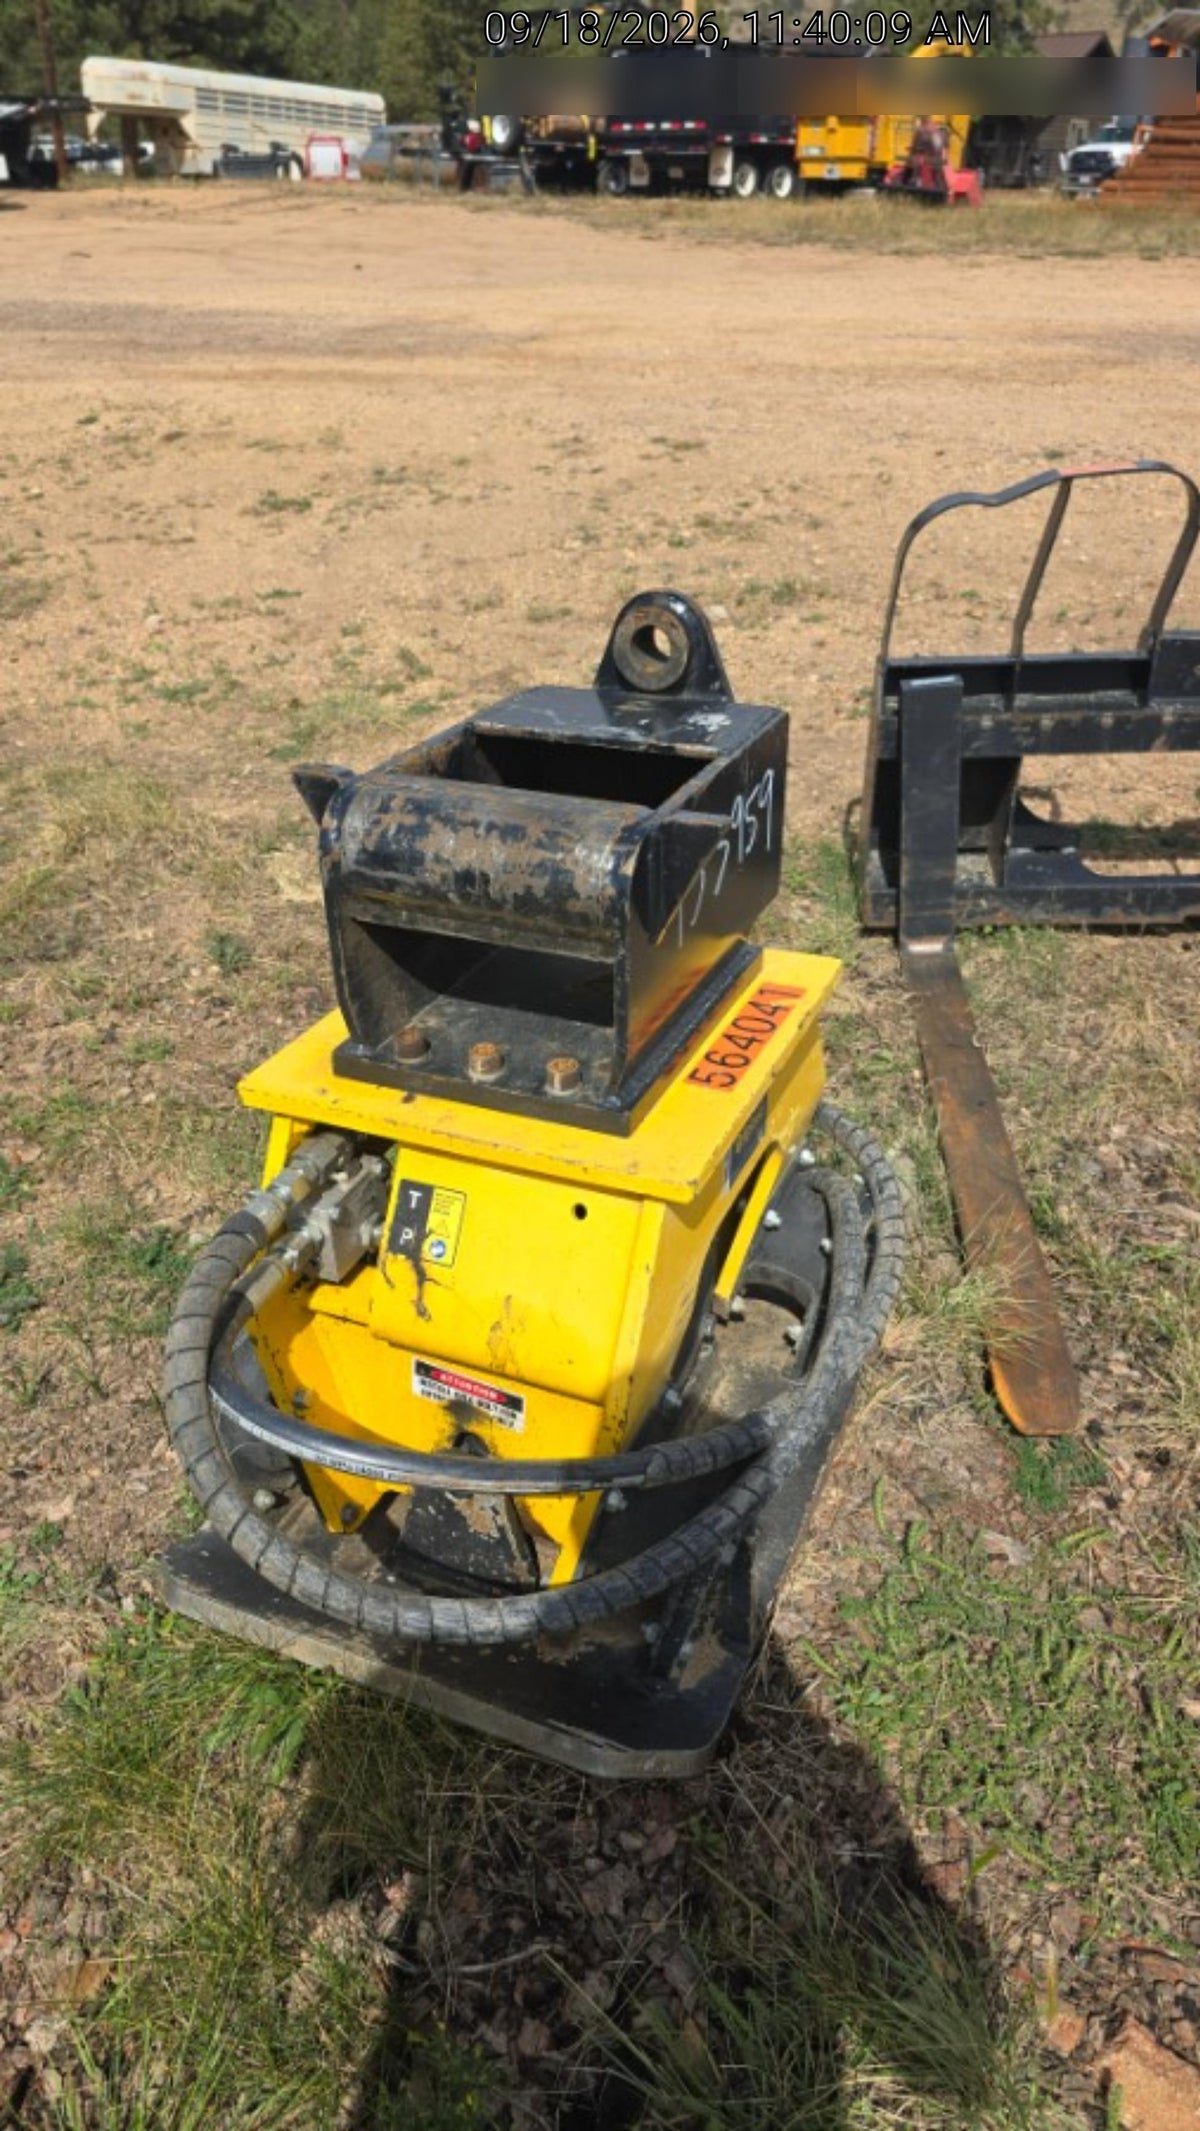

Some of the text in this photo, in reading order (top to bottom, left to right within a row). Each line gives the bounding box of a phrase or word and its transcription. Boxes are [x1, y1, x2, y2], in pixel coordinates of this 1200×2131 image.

[687, 988, 802, 1088] 564041
[408, 1190, 423, 1209] T
[399, 1227, 414, 1246] P
